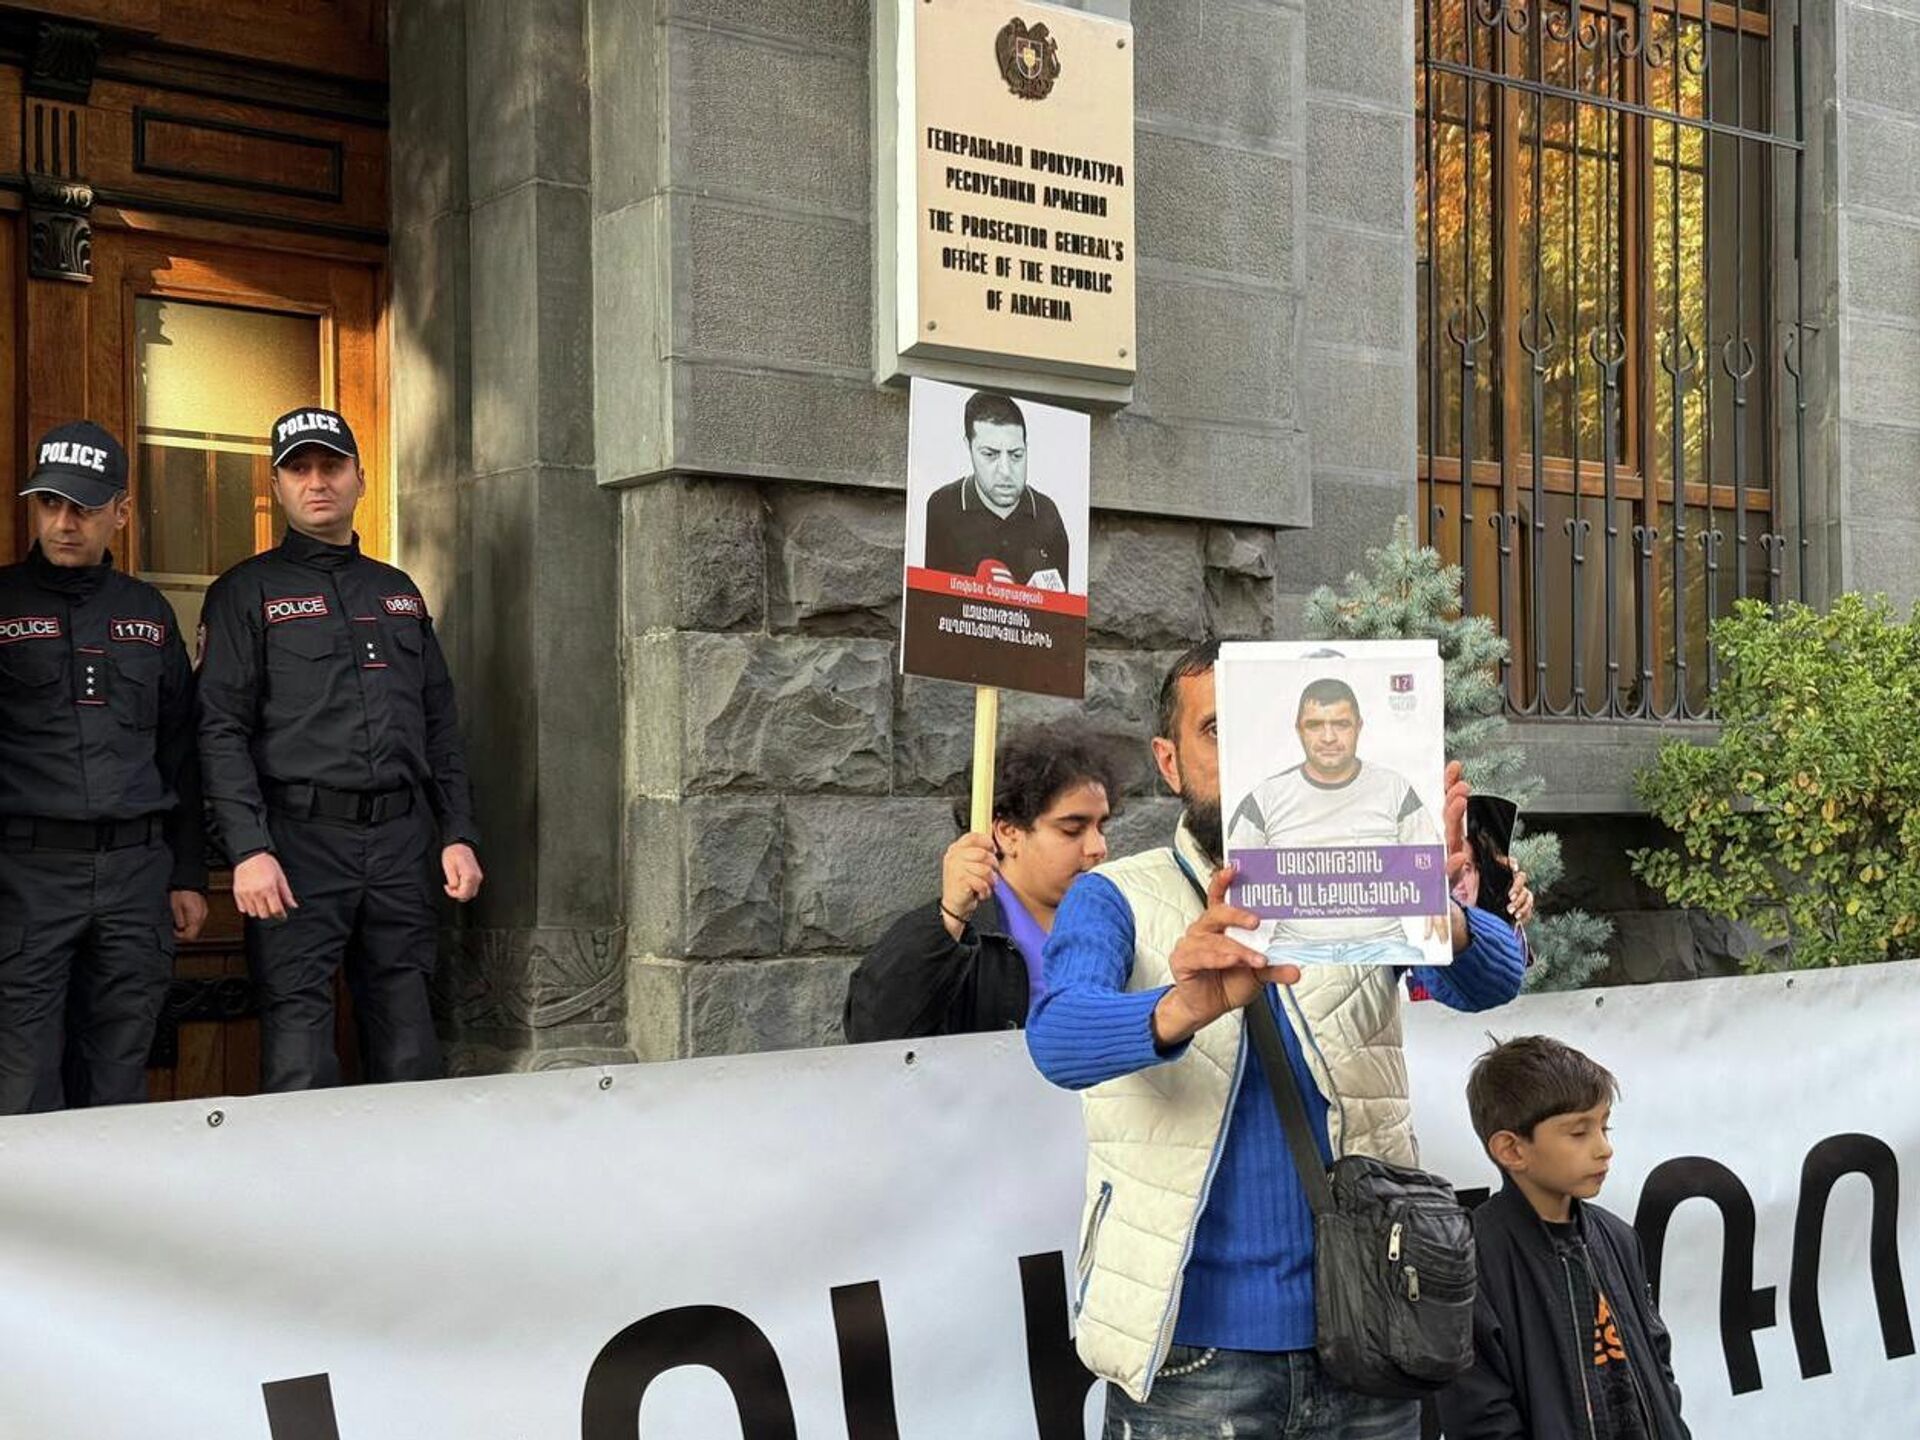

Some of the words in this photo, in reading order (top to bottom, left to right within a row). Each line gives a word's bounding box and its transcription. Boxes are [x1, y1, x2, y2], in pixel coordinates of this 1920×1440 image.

[927, 127, 1023, 167] ГЕНЕРАЛЬНАЯ
[1030, 149, 1124, 186] ПРОКУРАТУРА
[946, 167, 1036, 204] РЕСПУБЛИКИ
[928, 209, 954, 234] THE
[961, 214, 1048, 250] PROSECUTOR
[1055, 231, 1124, 262] GENERAL'S
[942, 247, 988, 275] OFFICE
[996, 256, 1012, 278] OF
[1020, 259, 1043, 284] THE
[1051, 265, 1112, 294] REPUBLIC
[987, 289, 1002, 311] OF
[1010, 293, 1072, 322] ARMENIA
[277, 413, 341, 443] POLICE
[39, 442, 108, 473] POLICE
[267, 600, 325, 619] POLICE
[0, 621, 57, 637] POLICE
[1276, 850, 1383, 875] ԱԶԱՏՈՒԹՅՈՒՆ
[1242, 884, 1293, 908] ԱՐՄԵՆ
[1298, 881, 1421, 907] ԱԼԵՔՍԱՆՅԱՆԻՆ
